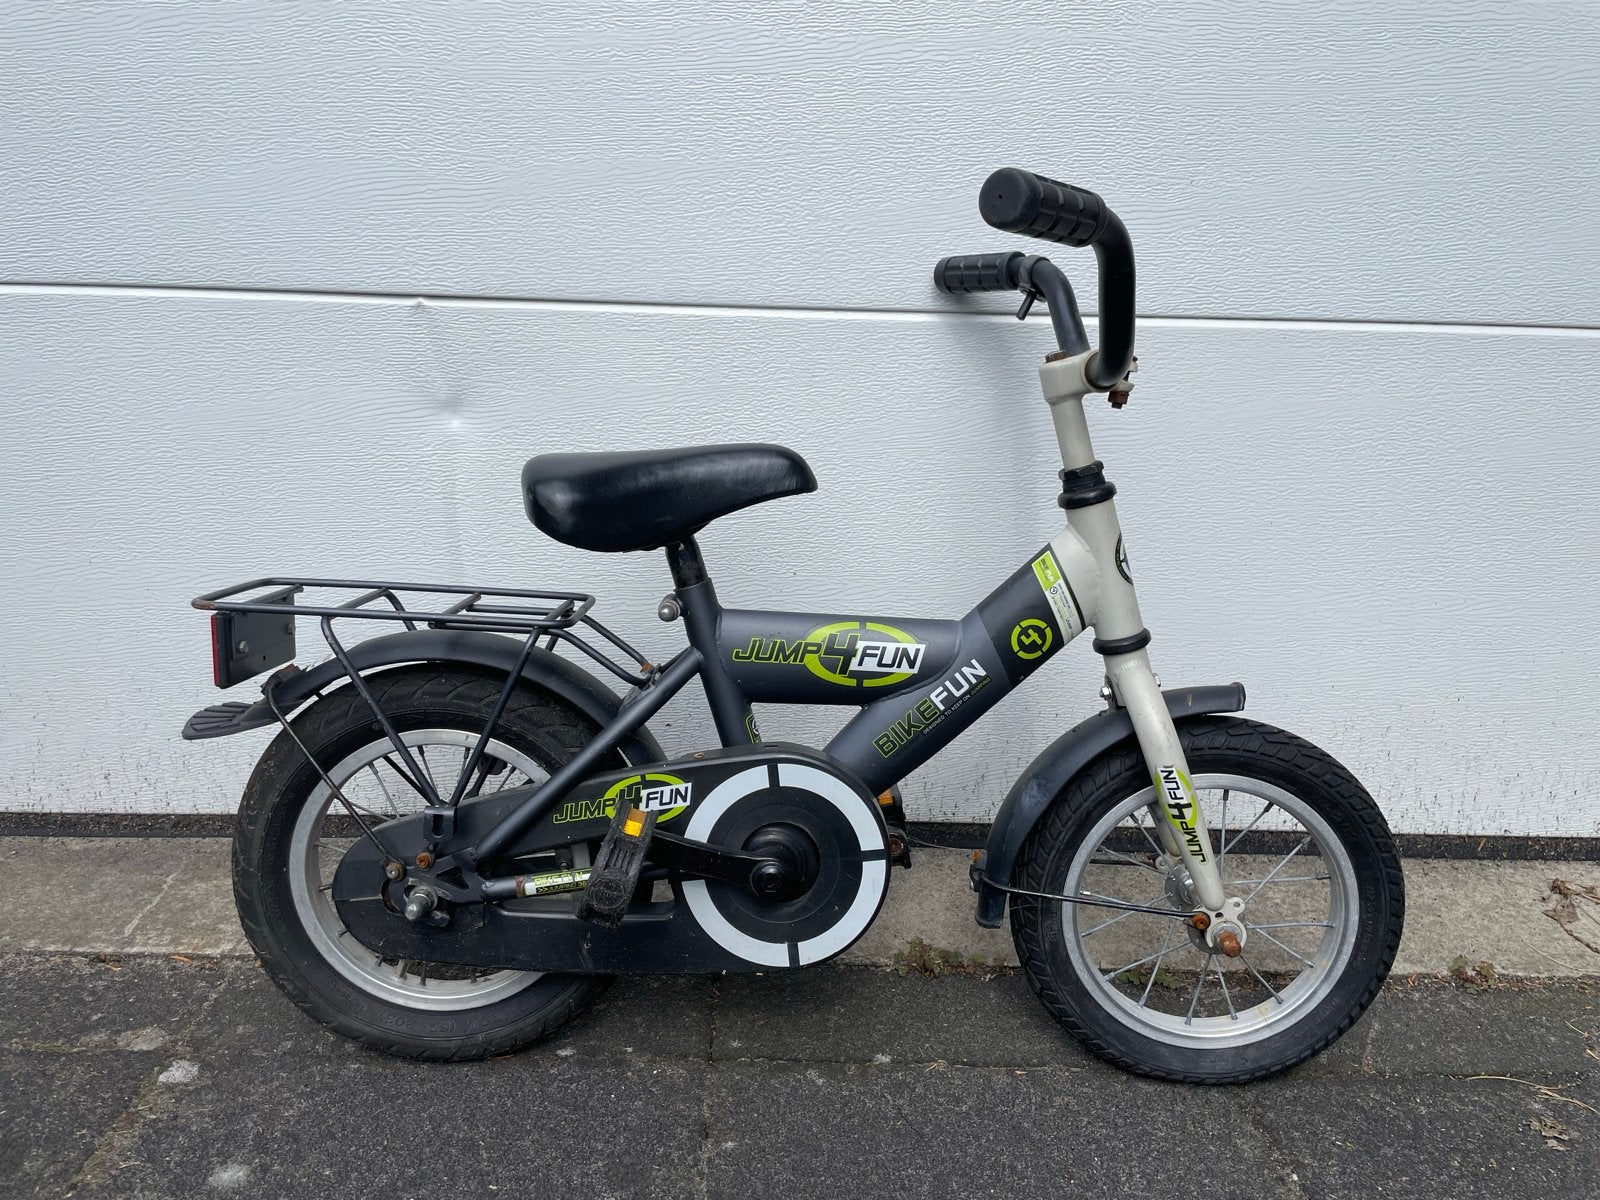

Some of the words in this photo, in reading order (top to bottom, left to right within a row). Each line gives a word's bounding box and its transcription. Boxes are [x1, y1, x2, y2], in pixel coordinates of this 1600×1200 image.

[1020, 628, 1043, 646] 4
[944, 709, 952, 717] TO
[951, 700, 963, 711] KEEP
[962, 694, 971, 702] ON
[970, 677, 991, 695] JUMPING
